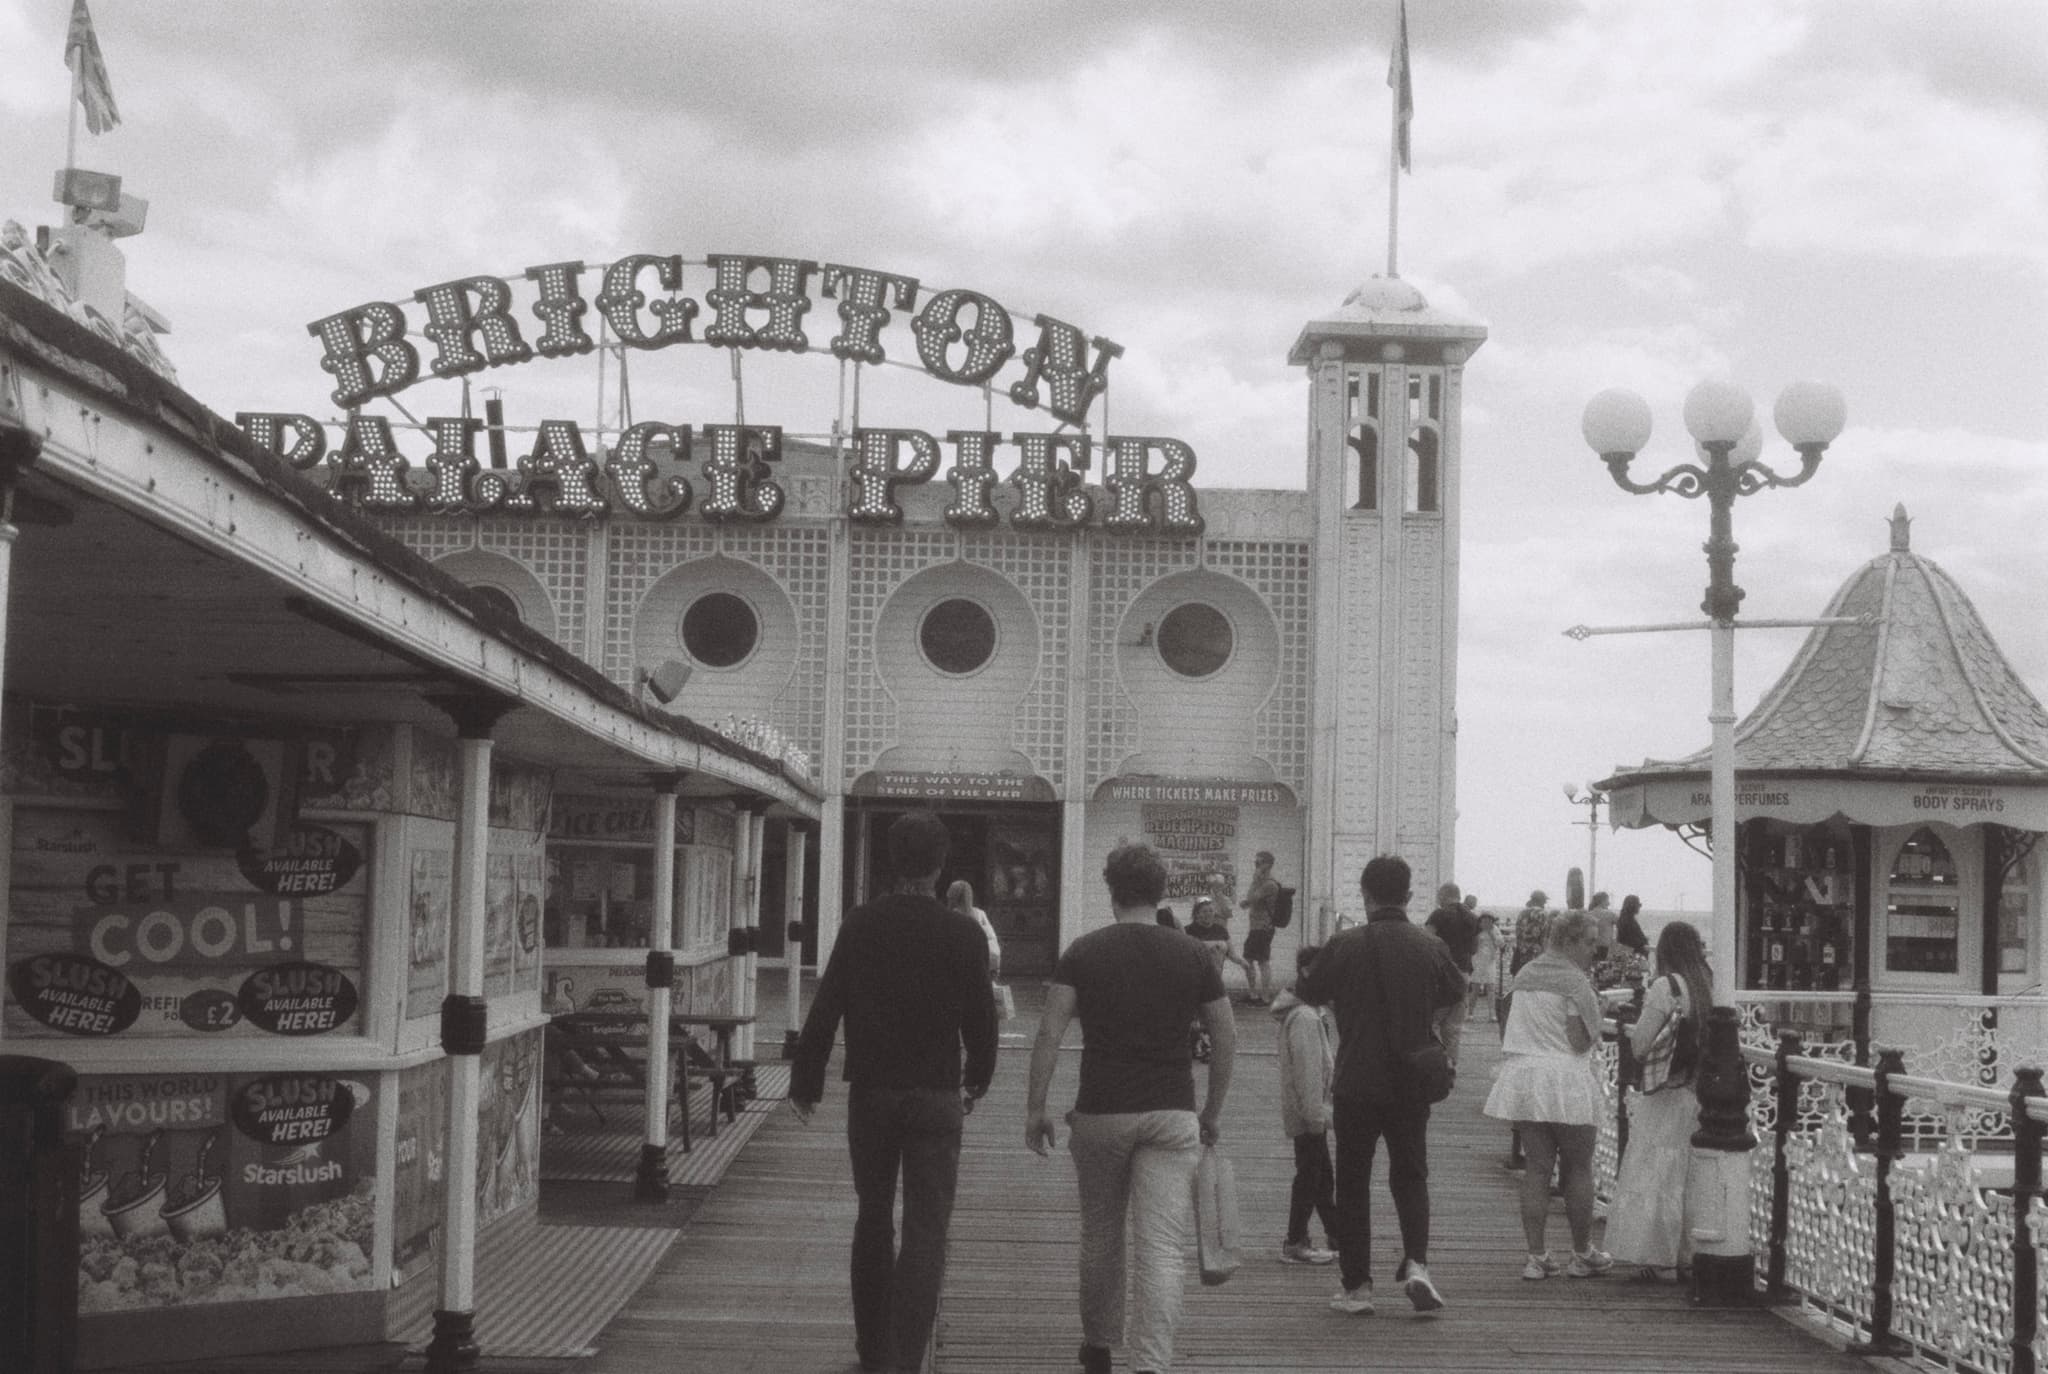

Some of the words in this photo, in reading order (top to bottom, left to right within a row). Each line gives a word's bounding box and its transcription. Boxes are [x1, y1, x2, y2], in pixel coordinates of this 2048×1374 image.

[307, 254, 1124, 428] BRIGHTON
[235, 411, 785, 520] PALACE
[848, 427, 1204, 534] PIER
[58, 725, 128, 772] SL
[885, 775, 919, 784] THIS
[925, 776, 962, 786] WAY
[968, 778, 989, 786] TO
[997, 778, 1024, 787] THE
[886, 787, 919, 796] END
[926, 788, 946, 796] OF
[953, 788, 981, 797] THE
[986, 790, 1021, 799] PIER
[1112, 786, 1151, 800] WHERE
[1156, 787, 1200, 801] TICKETS
[1205, 788, 1236, 801] MAKE
[1241, 789, 1279, 803] PRIZES
[1691, 793, 1712, 806] ARA
[1913, 795, 1949, 810] BODY
[1953, 796, 2005, 812] SPRAYS
[605, 810, 655, 833] CREA
[1145, 819, 1235, 838] REDEMPTION
[1155, 834, 1225, 850] MACHINES
[264, 858, 334, 872] AVAILABLE
[85, 862, 181, 905] GET
[277, 872, 337, 892] HERE!
[90, 899, 291, 967] COOL!
[30, 957, 128, 1000] SLUSH
[252, 969, 342, 1000] SLUSH
[38, 988, 116, 1013] AVAILABLE
[208, 1000, 235, 1025] £2
[264, 996, 334, 1011] AVAILABLE
[49, 1005, 115, 1034] HERE!
[164, 1011, 180, 1021] FO
[277, 1010, 337, 1031] HERE!
[85, 1081, 134, 1102] THIS
[142, 1076, 218, 1098] WORLD
[247, 1078, 337, 1112] SLUSH
[71, 1097, 213, 1129] LAVOURS!
[258, 1104, 330, 1123] AVAILABLE
[272, 1118, 332, 1142] HERE!
[243, 1160, 343, 1184] Starslush
